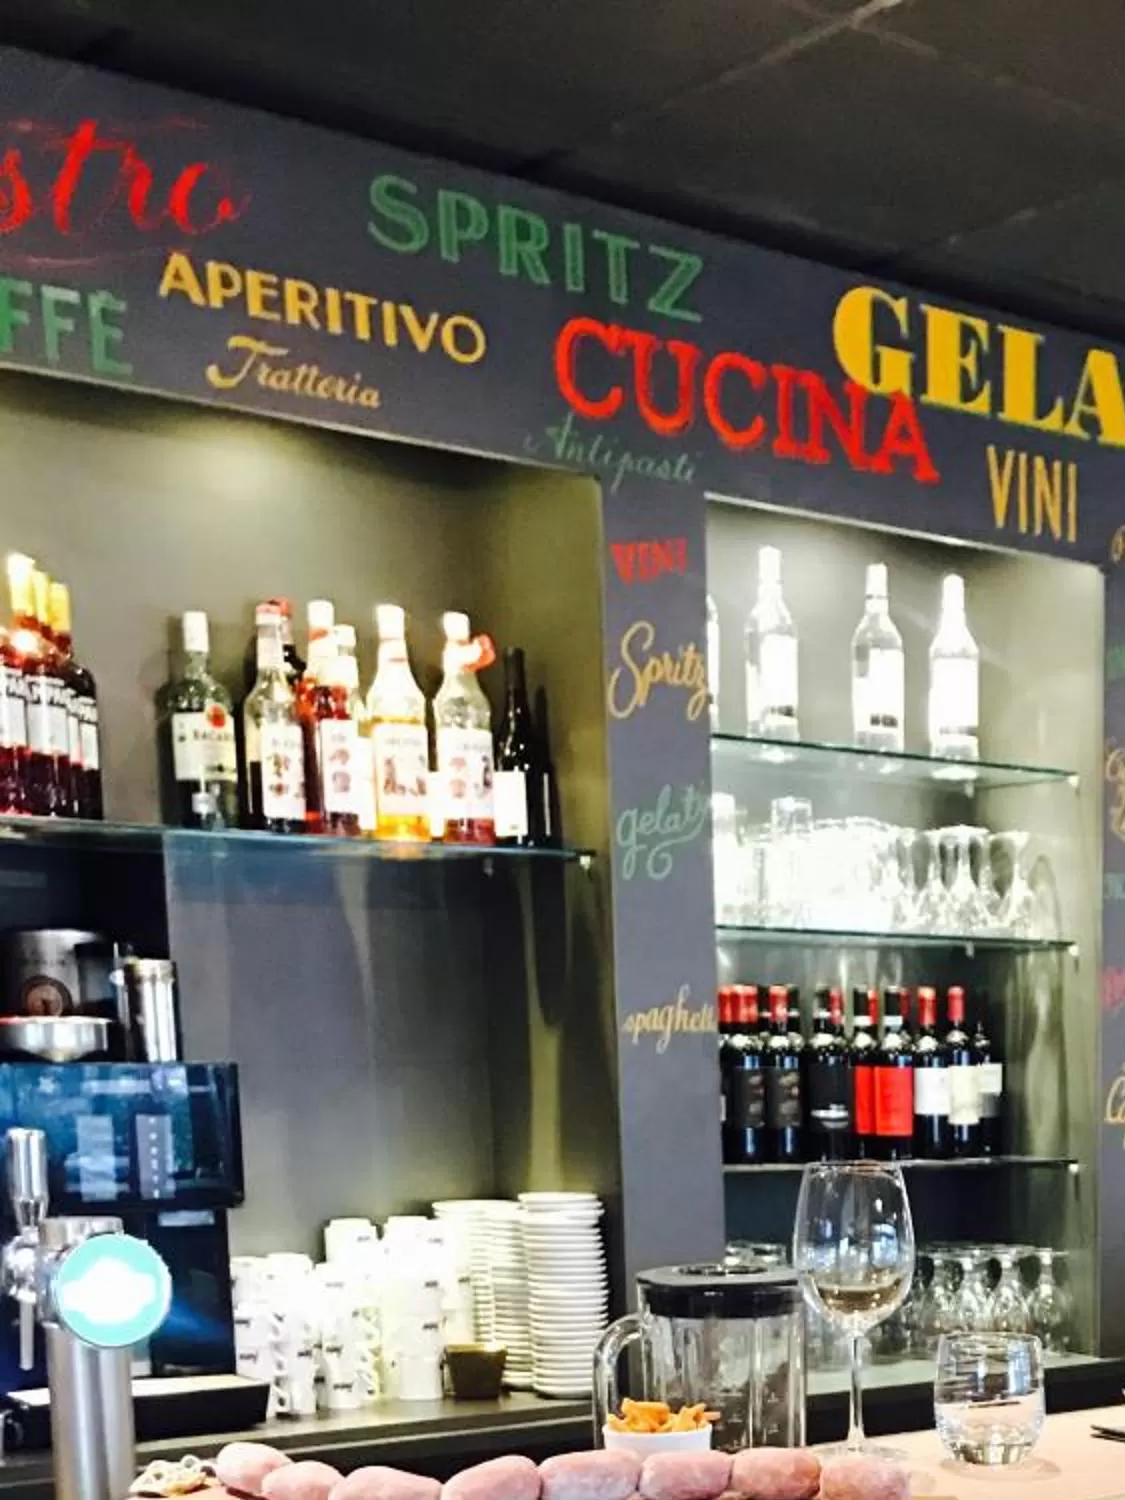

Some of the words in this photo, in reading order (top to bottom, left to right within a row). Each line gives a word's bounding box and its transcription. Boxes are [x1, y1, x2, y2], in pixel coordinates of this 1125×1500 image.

[368, 174, 704, 322] SPRITZ
[159, 252, 486, 364] APERITIVO
[206, 336, 381, 409] Trattoria
[554, 317, 940, 483] CUCINA
[987, 446, 1078, 542] VINI
[609, 537, 688, 586] VINI
[608, 620, 709, 720] Spritz
